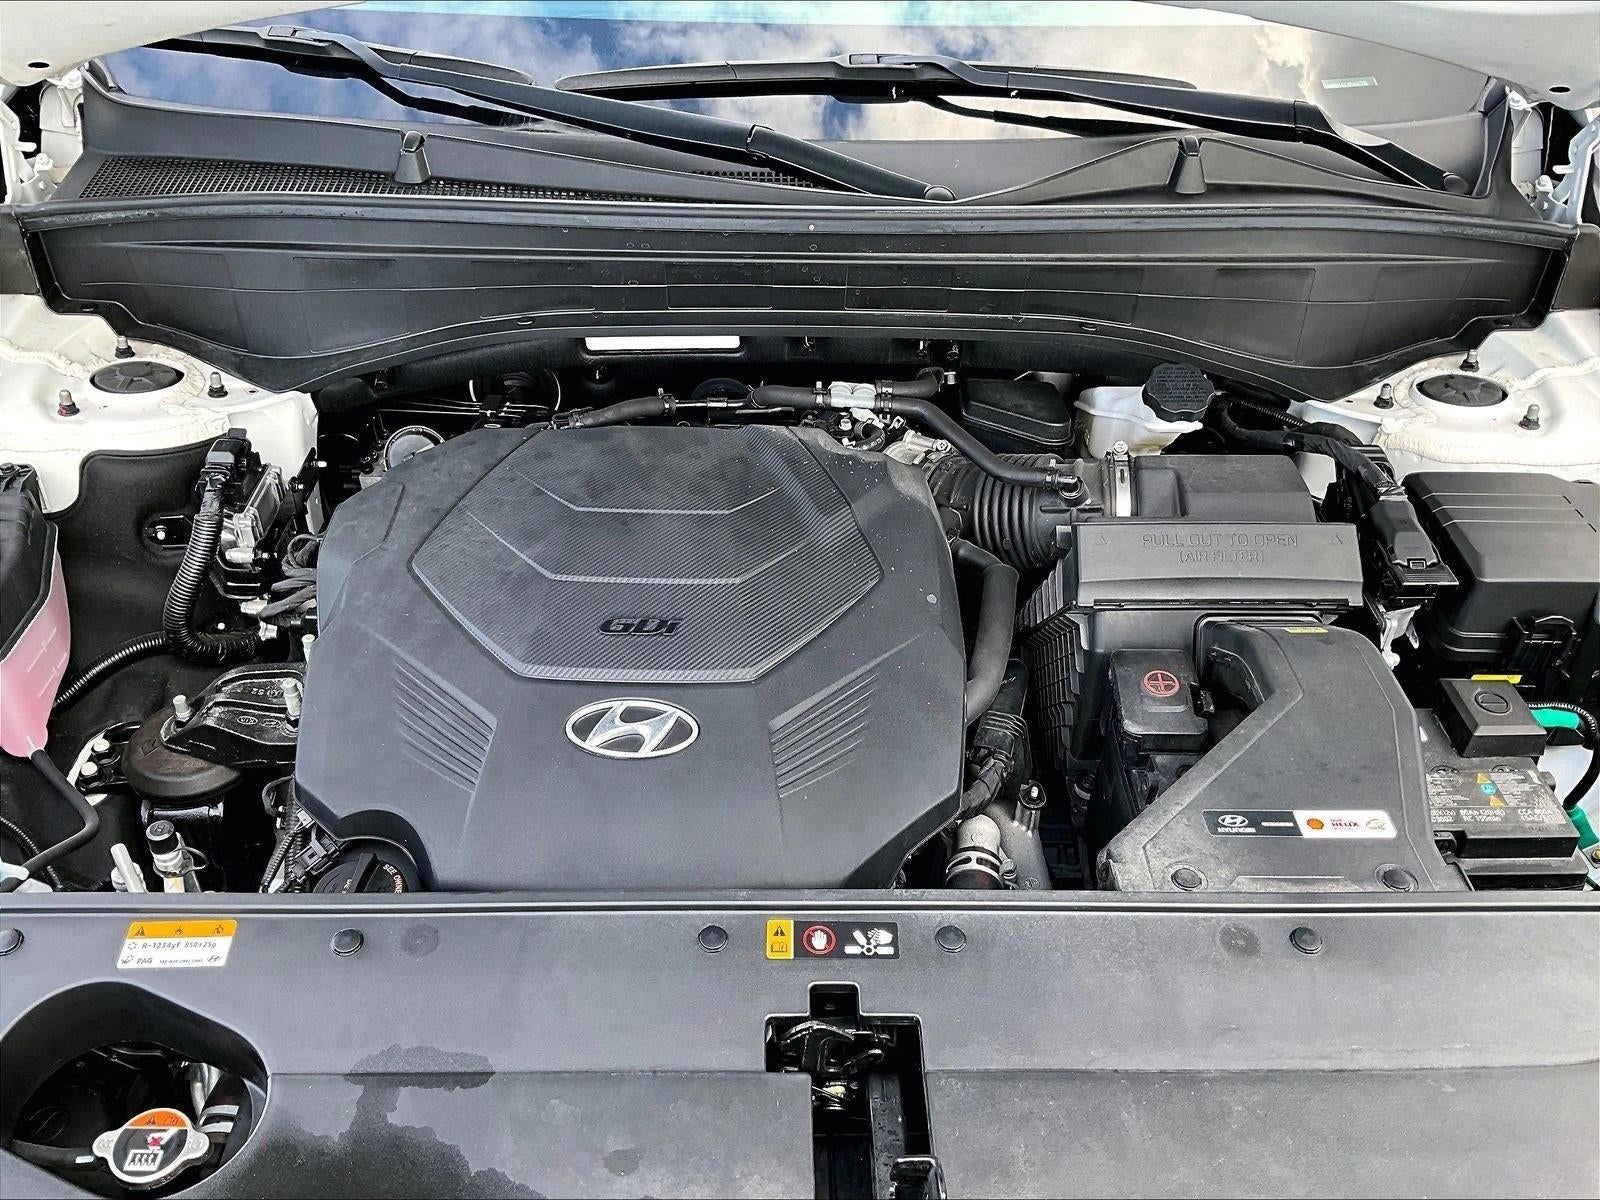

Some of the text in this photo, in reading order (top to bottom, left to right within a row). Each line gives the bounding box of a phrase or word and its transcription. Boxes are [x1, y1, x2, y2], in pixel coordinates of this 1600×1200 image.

[1142, 533, 1298, 548] PULL OUT TO OPEN
[383, 863, 402, 894] SEE OWNE
[141, 941, 180, 951] R-1234yf
